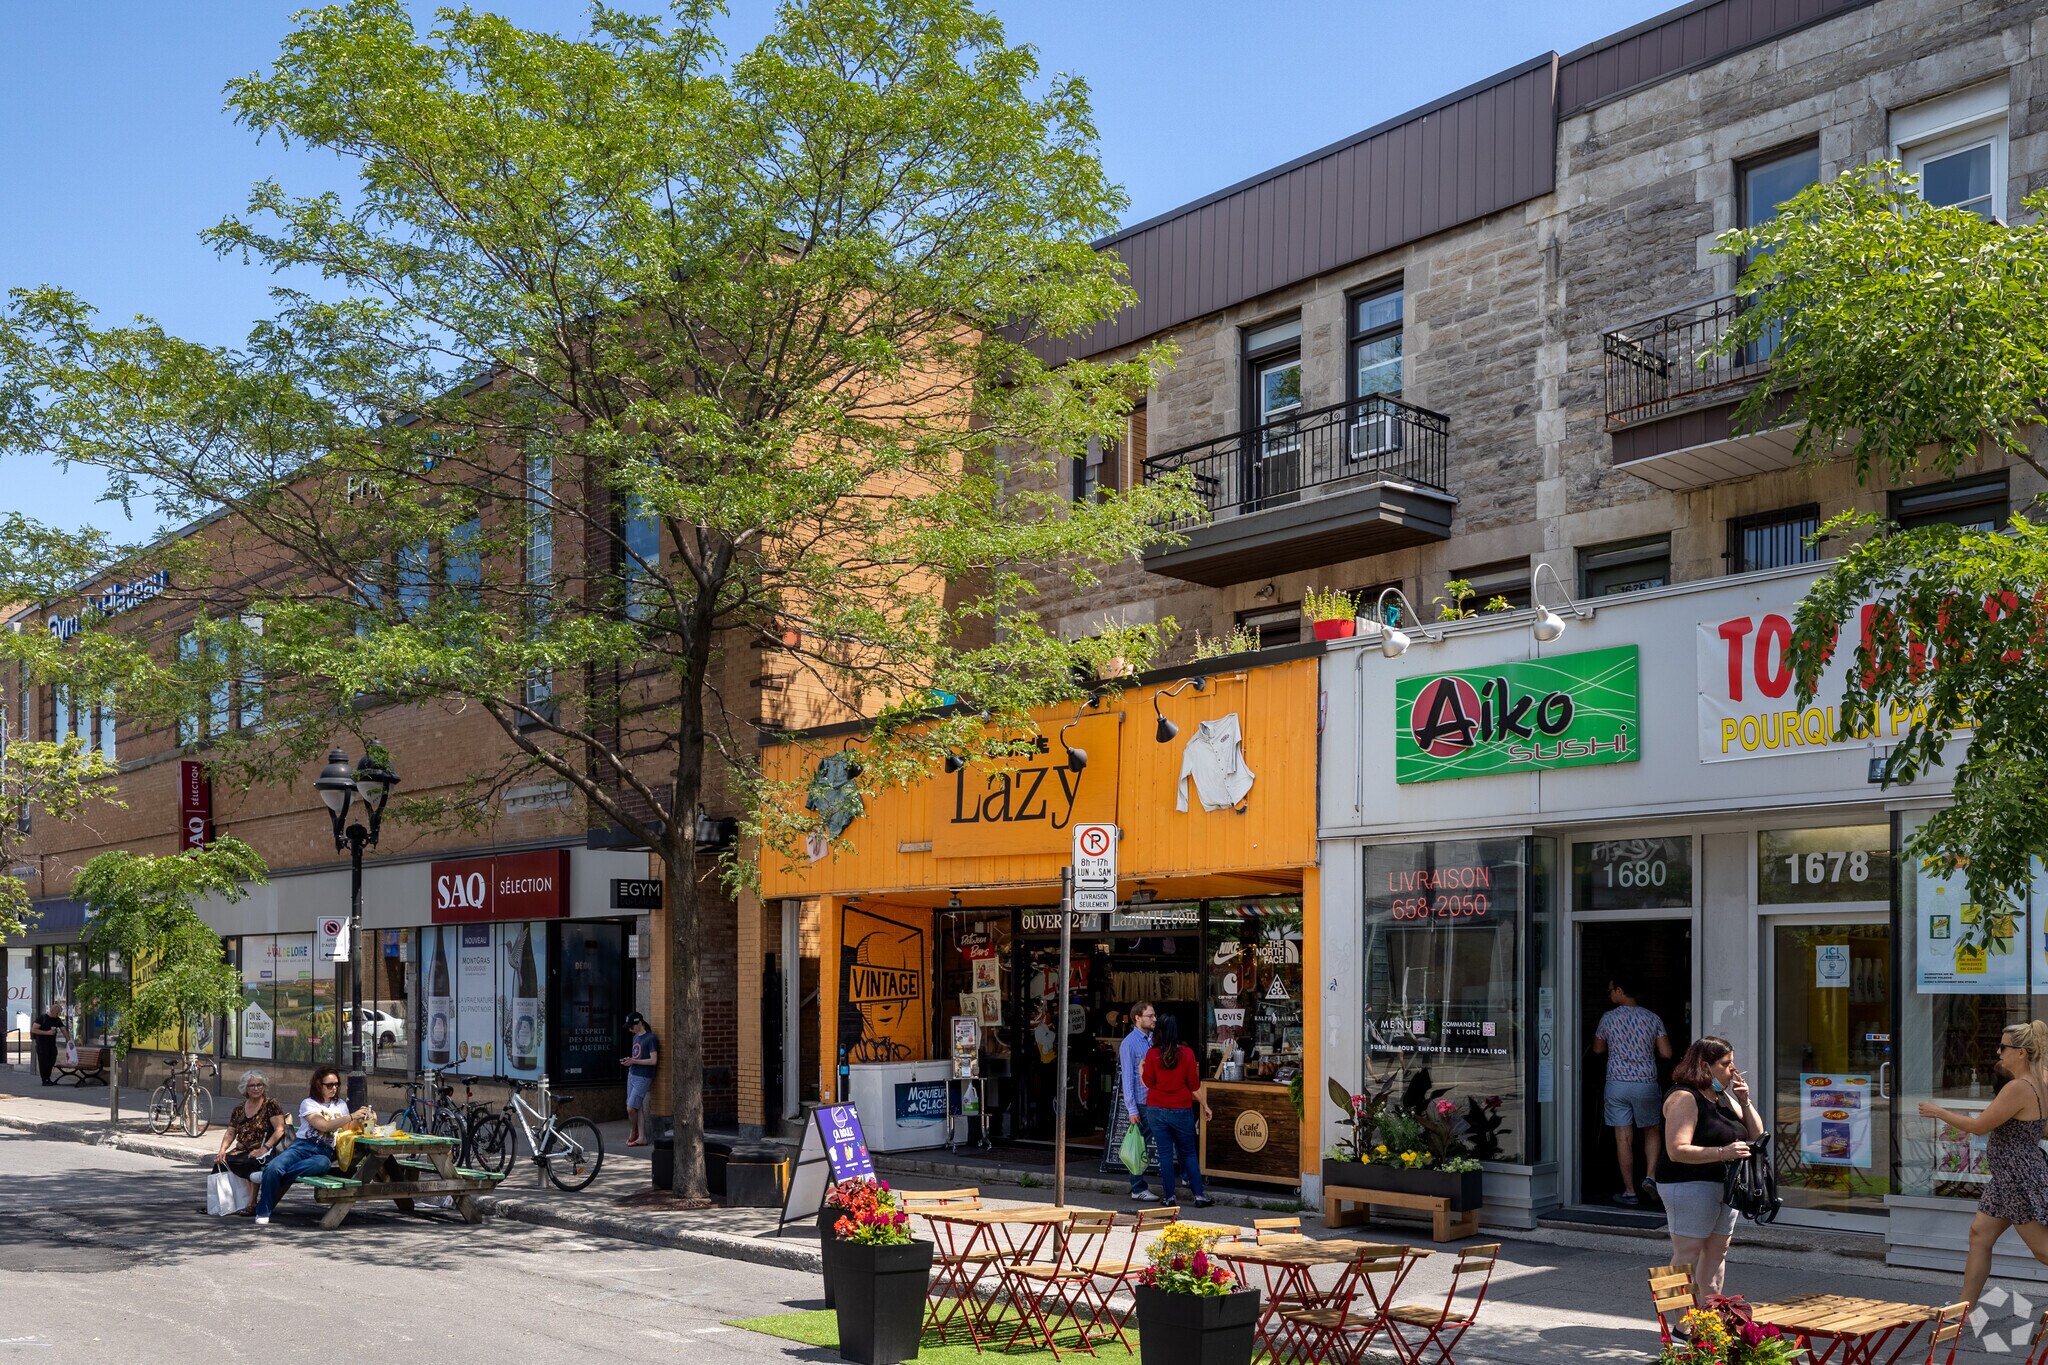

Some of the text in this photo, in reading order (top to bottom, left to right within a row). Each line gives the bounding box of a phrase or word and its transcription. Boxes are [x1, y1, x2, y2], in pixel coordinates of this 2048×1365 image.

[1719, 613, 1838, 702] TO
[1414, 676, 1574, 750] Aiko
[951, 766, 1087, 829] Lazy
[1077, 868, 1090, 876] LUN
[1098, 867, 1112, 876] SAM
[1603, 860, 1667, 888] 1680
[1785, 852, 1869, 884] 1678
[1389, 866, 1489, 892] LIVRAISON
[437, 872, 552, 909] SAQ SÉLECTION
[1392, 893, 1487, 920] 658-2050
[1022, 913, 1098, 930] OUVER 24/7
[1111, 910, 1198, 929] LazyMTL.com
[464, 937, 487, 945] NOUVEAU
[1219, 942, 1240, 954] NIKE
[970, 945, 990, 958] Bars
[1256, 948, 1284, 956] NORTH
[1264, 956, 1284, 964] FACE
[853, 969, 918, 998] VINTAGE
[1380, 1020, 1411, 1029] MENU
[1243, 1123, 1260, 1131] café
